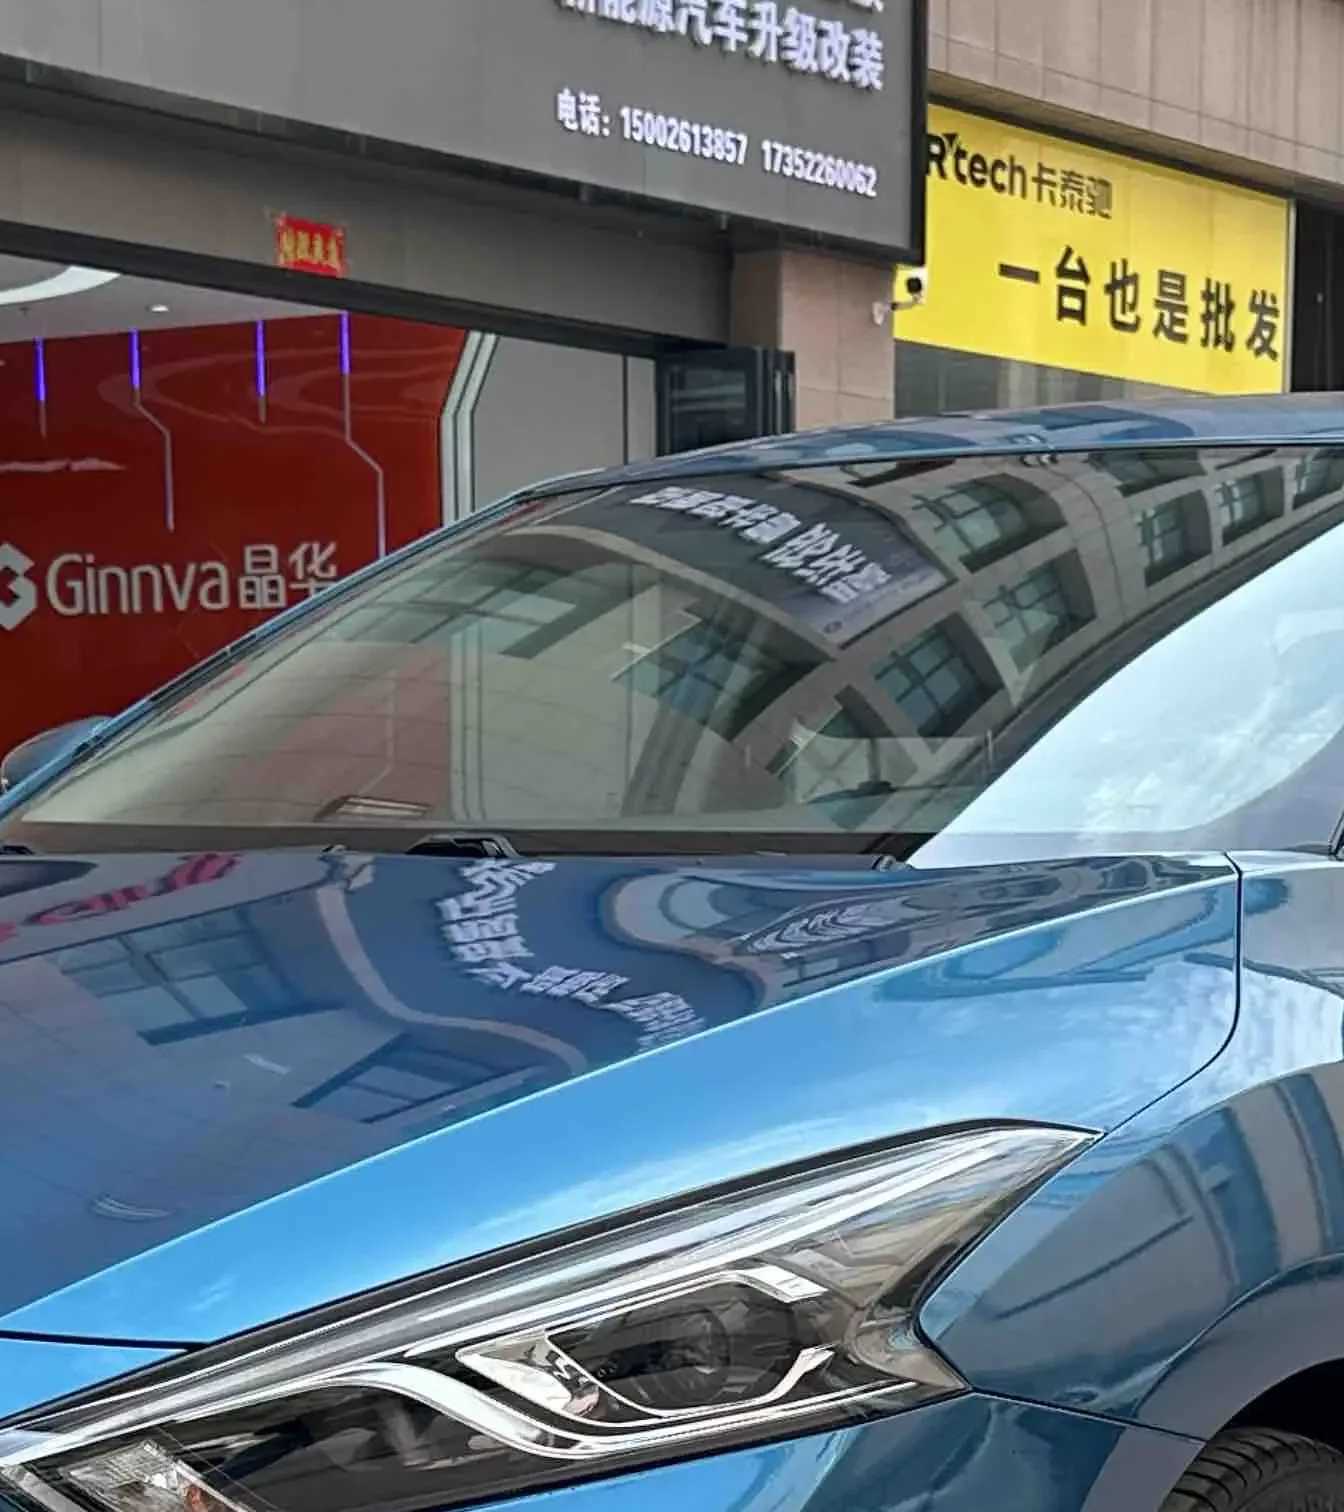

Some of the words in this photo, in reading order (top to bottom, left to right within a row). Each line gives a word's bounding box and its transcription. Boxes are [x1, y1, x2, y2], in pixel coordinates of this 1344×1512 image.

[559, 0, 884, 90] 源汽车升级改装
[997, 245, 1281, 362] 一台也是批发
